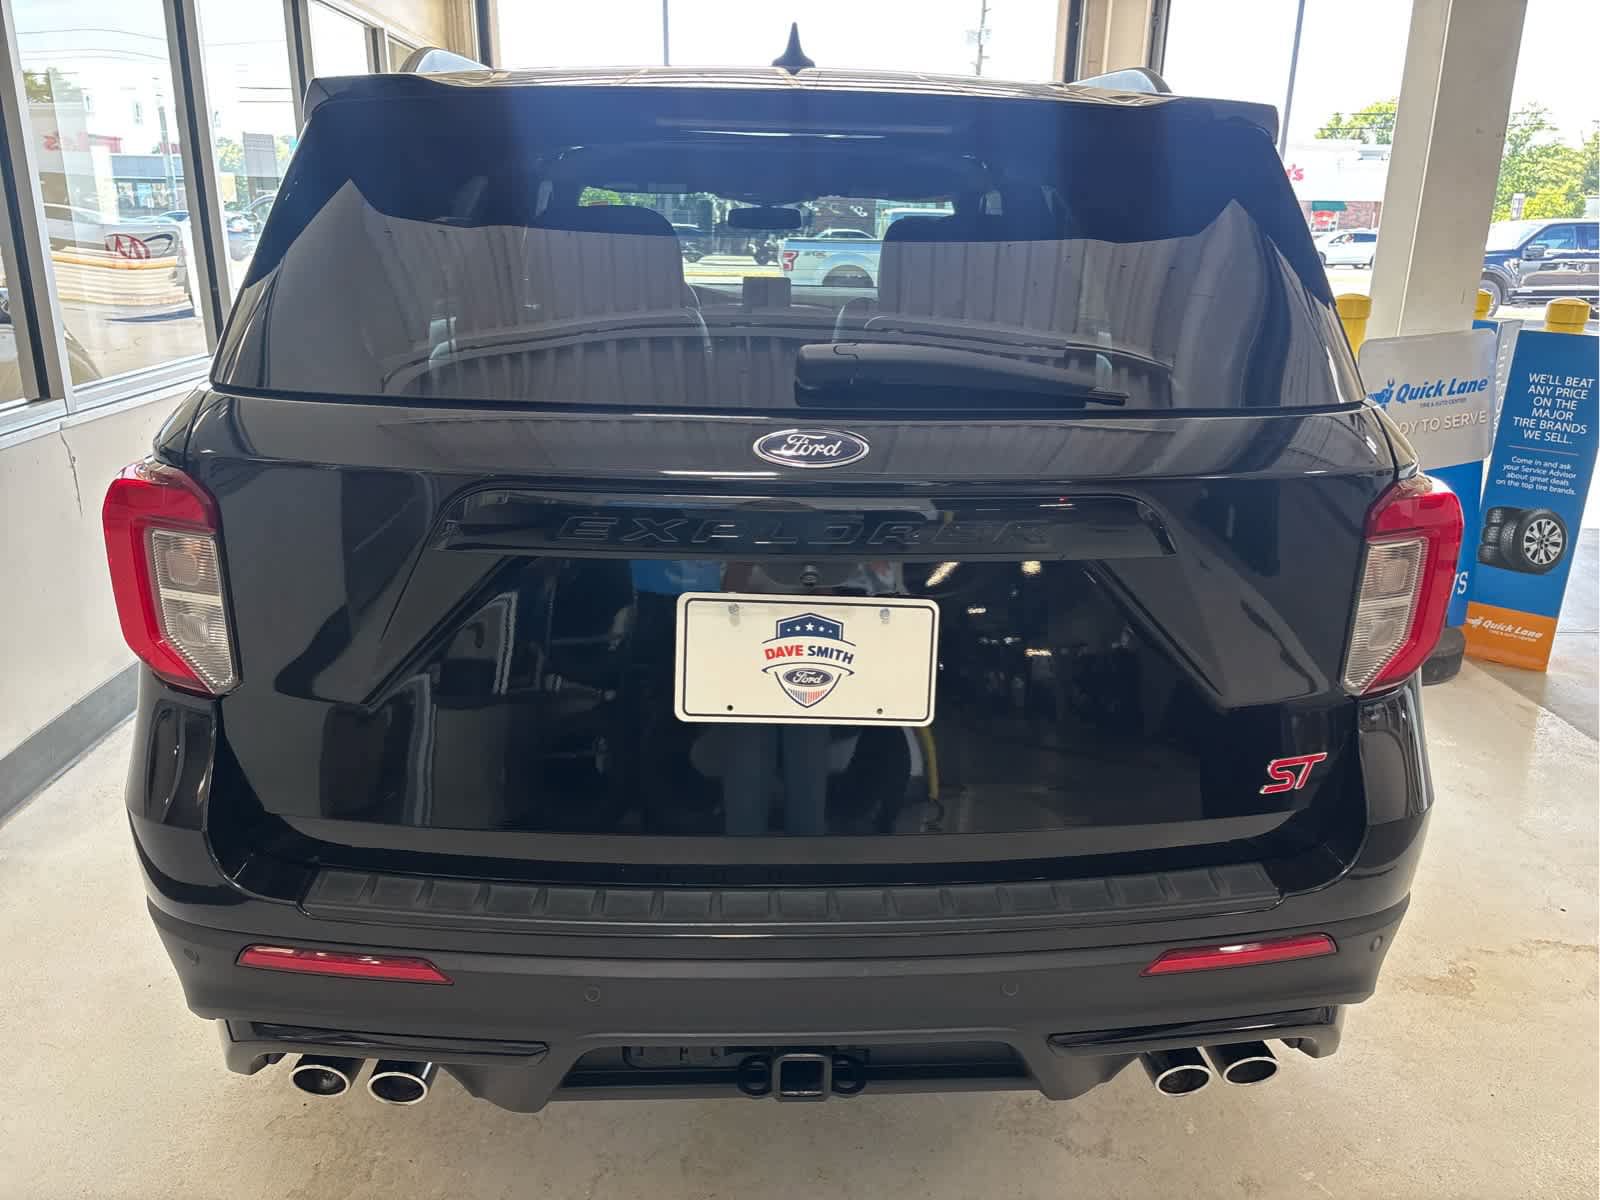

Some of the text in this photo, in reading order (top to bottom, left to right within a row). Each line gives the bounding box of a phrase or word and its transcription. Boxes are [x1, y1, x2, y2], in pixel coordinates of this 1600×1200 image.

[1528, 372, 1595, 389] WE'LL BEAT
[1395, 378, 1489, 404] Quick Lane
[1527, 385, 1589, 400] ANY PRICE
[1533, 396, 1579, 410] ON THE
[1422, 417, 1440, 432] TO
[1443, 410, 1488, 430] SERVE
[1531, 407, 1574, 421] MAJOR
[1513, 416, 1588, 435] TIRE BRANDS
[1523, 429, 1573, 444] WE SELL.
[779, 434, 842, 457] Ford
[1511, 455, 1534, 465] Come
[1542, 461, 1559, 469] and
[1506, 471, 1529, 480] about
[1529, 475, 1549, 483] great
[1521, 465, 1547, 475] Service
[1548, 469, 1577, 479] Advisor
[1521, 482, 1534, 490] top
[1535, 484, 1548, 492] tire
[1482, 619, 1514, 633] Quick
[1514, 625, 1544, 639] Lane
[764, 644, 855, 665] DAVE SMITH
[792, 670, 824, 684] Ford
[1259, 752, 1328, 794] ST
